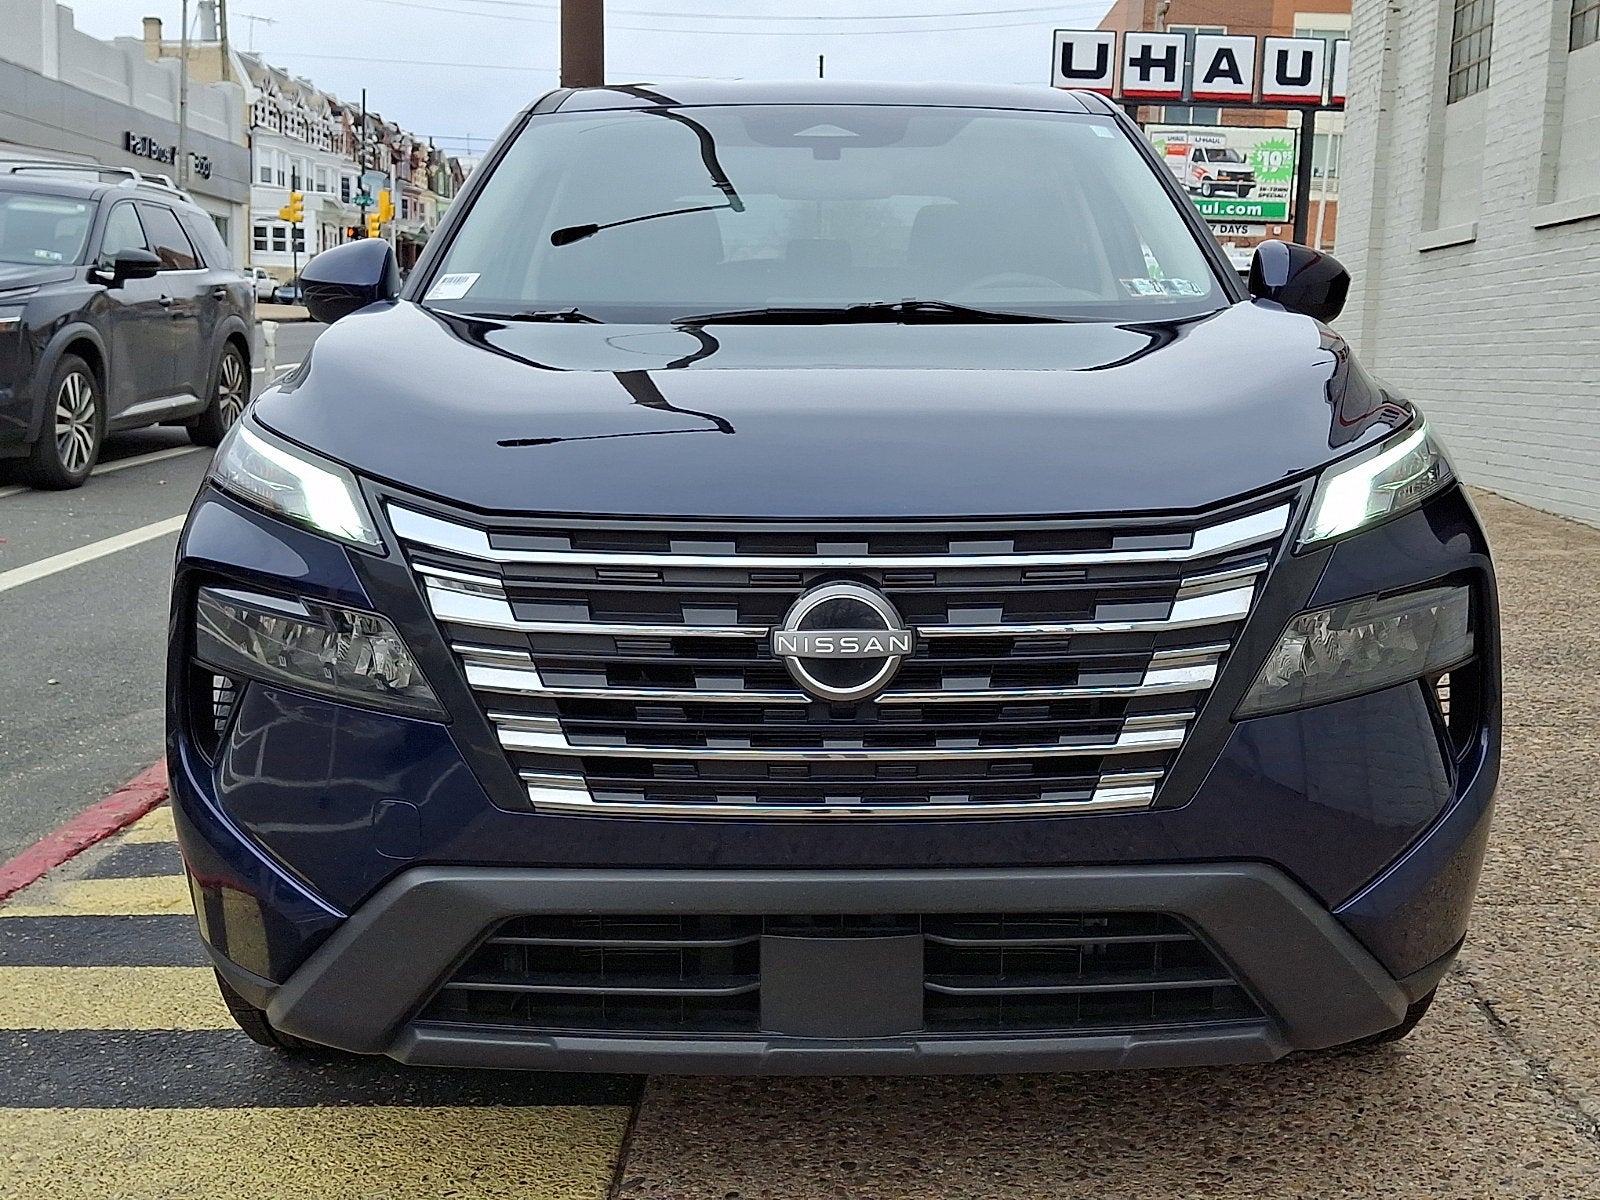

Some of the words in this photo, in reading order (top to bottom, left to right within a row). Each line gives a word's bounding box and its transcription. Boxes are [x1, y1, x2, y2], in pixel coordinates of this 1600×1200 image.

[1061, 42, 1313, 87] UHAU
[1220, 224, 1248, 234] DAYS
[777, 635, 909, 653] NISSAN
